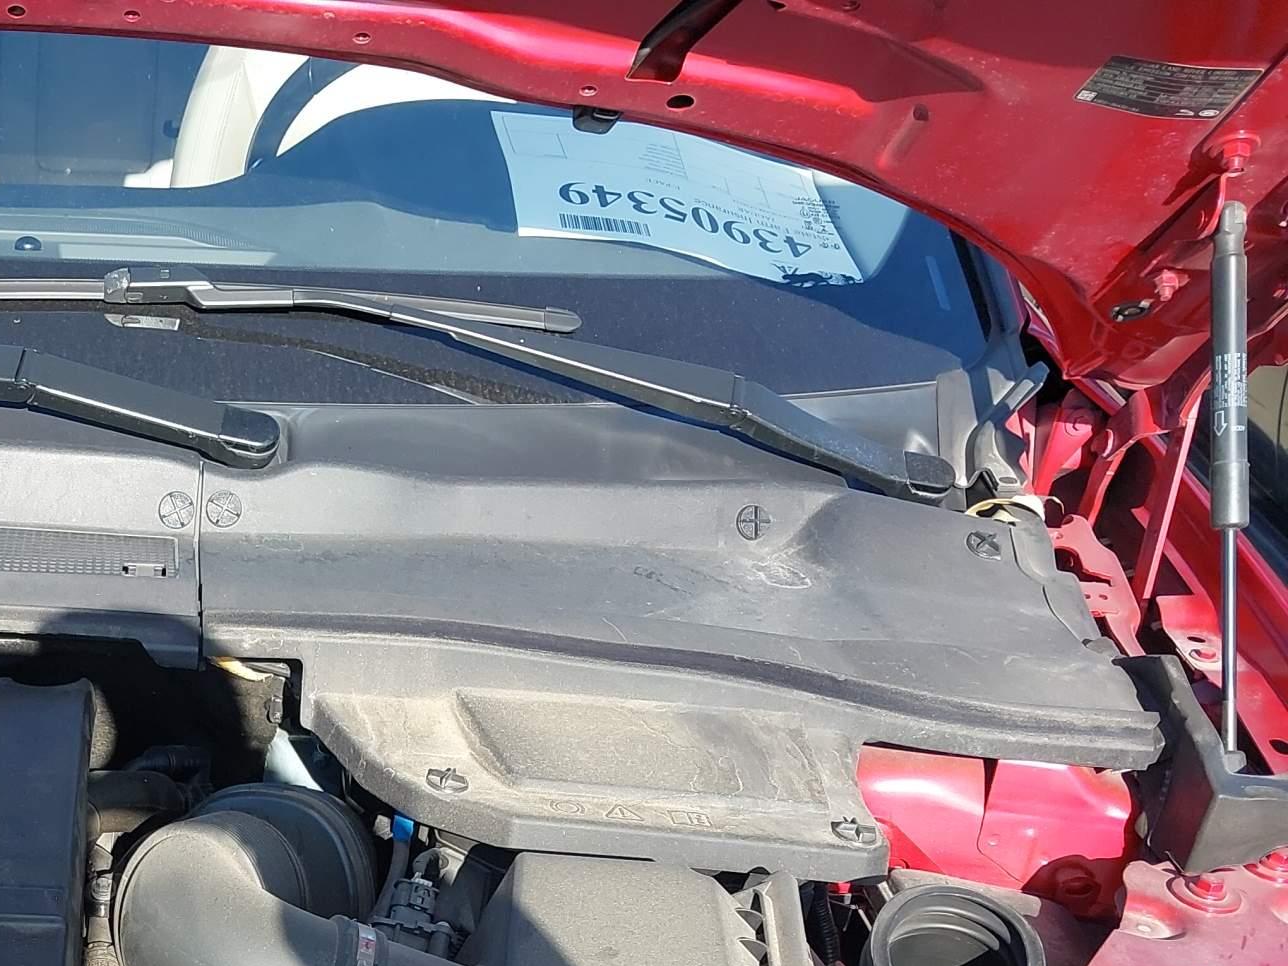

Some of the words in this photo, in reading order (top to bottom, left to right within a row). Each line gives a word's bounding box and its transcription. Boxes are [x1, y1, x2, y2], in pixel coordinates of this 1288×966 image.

[558, 181, 811, 258] 43905349
[693, 197, 751, 227] Insurance
[751, 215, 788, 235] Farm
